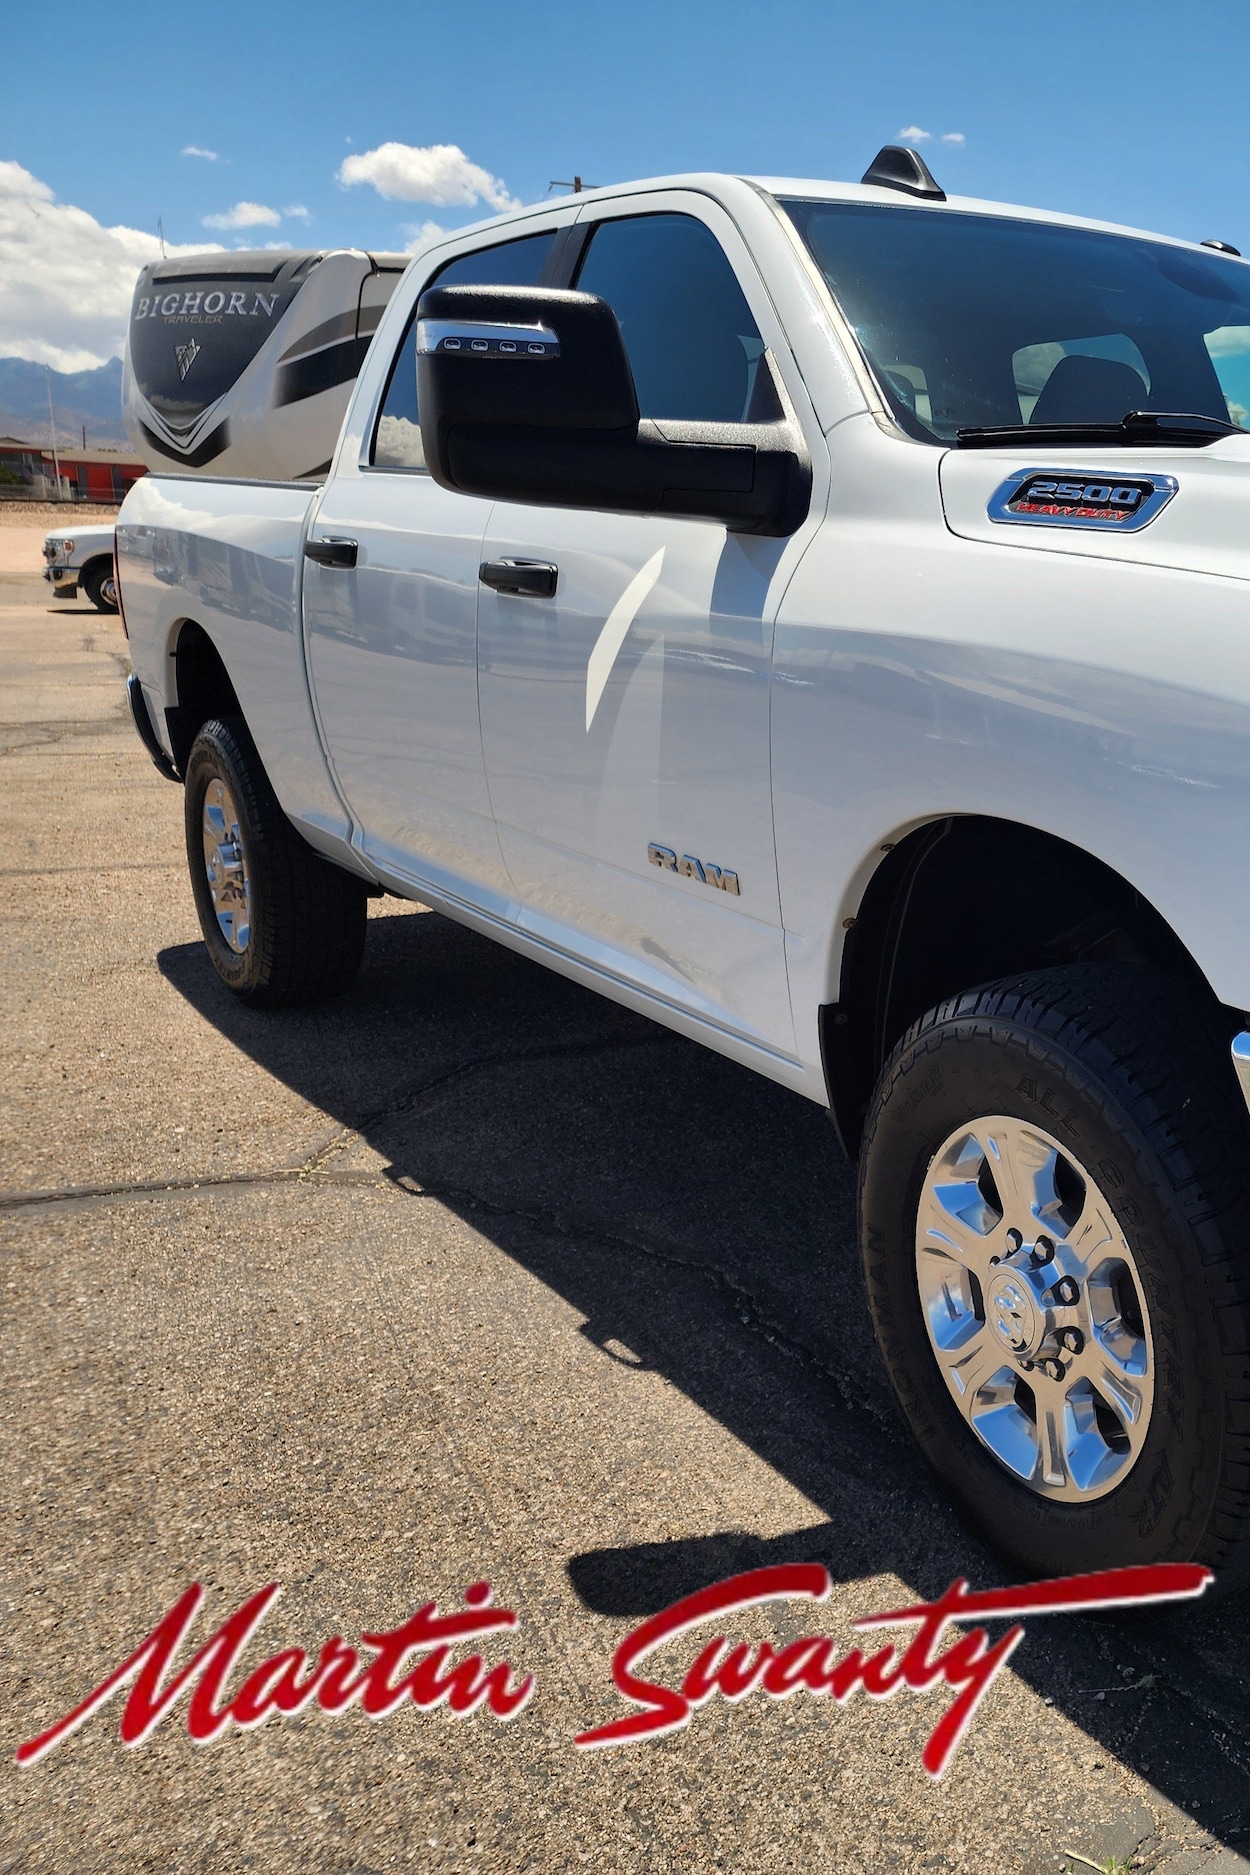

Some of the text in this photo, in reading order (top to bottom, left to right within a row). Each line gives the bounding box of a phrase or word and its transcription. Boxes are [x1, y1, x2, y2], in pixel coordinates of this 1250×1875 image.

[135, 291, 280, 320] BIGHORN
[162, 314, 223, 325] TRAVELER
[1027, 480, 1143, 504] 2500
[1016, 502, 1131, 520] HEAVY DUTY
[647, 842, 741, 897] RAM
[1013, 1073, 1082, 1140] ALL
